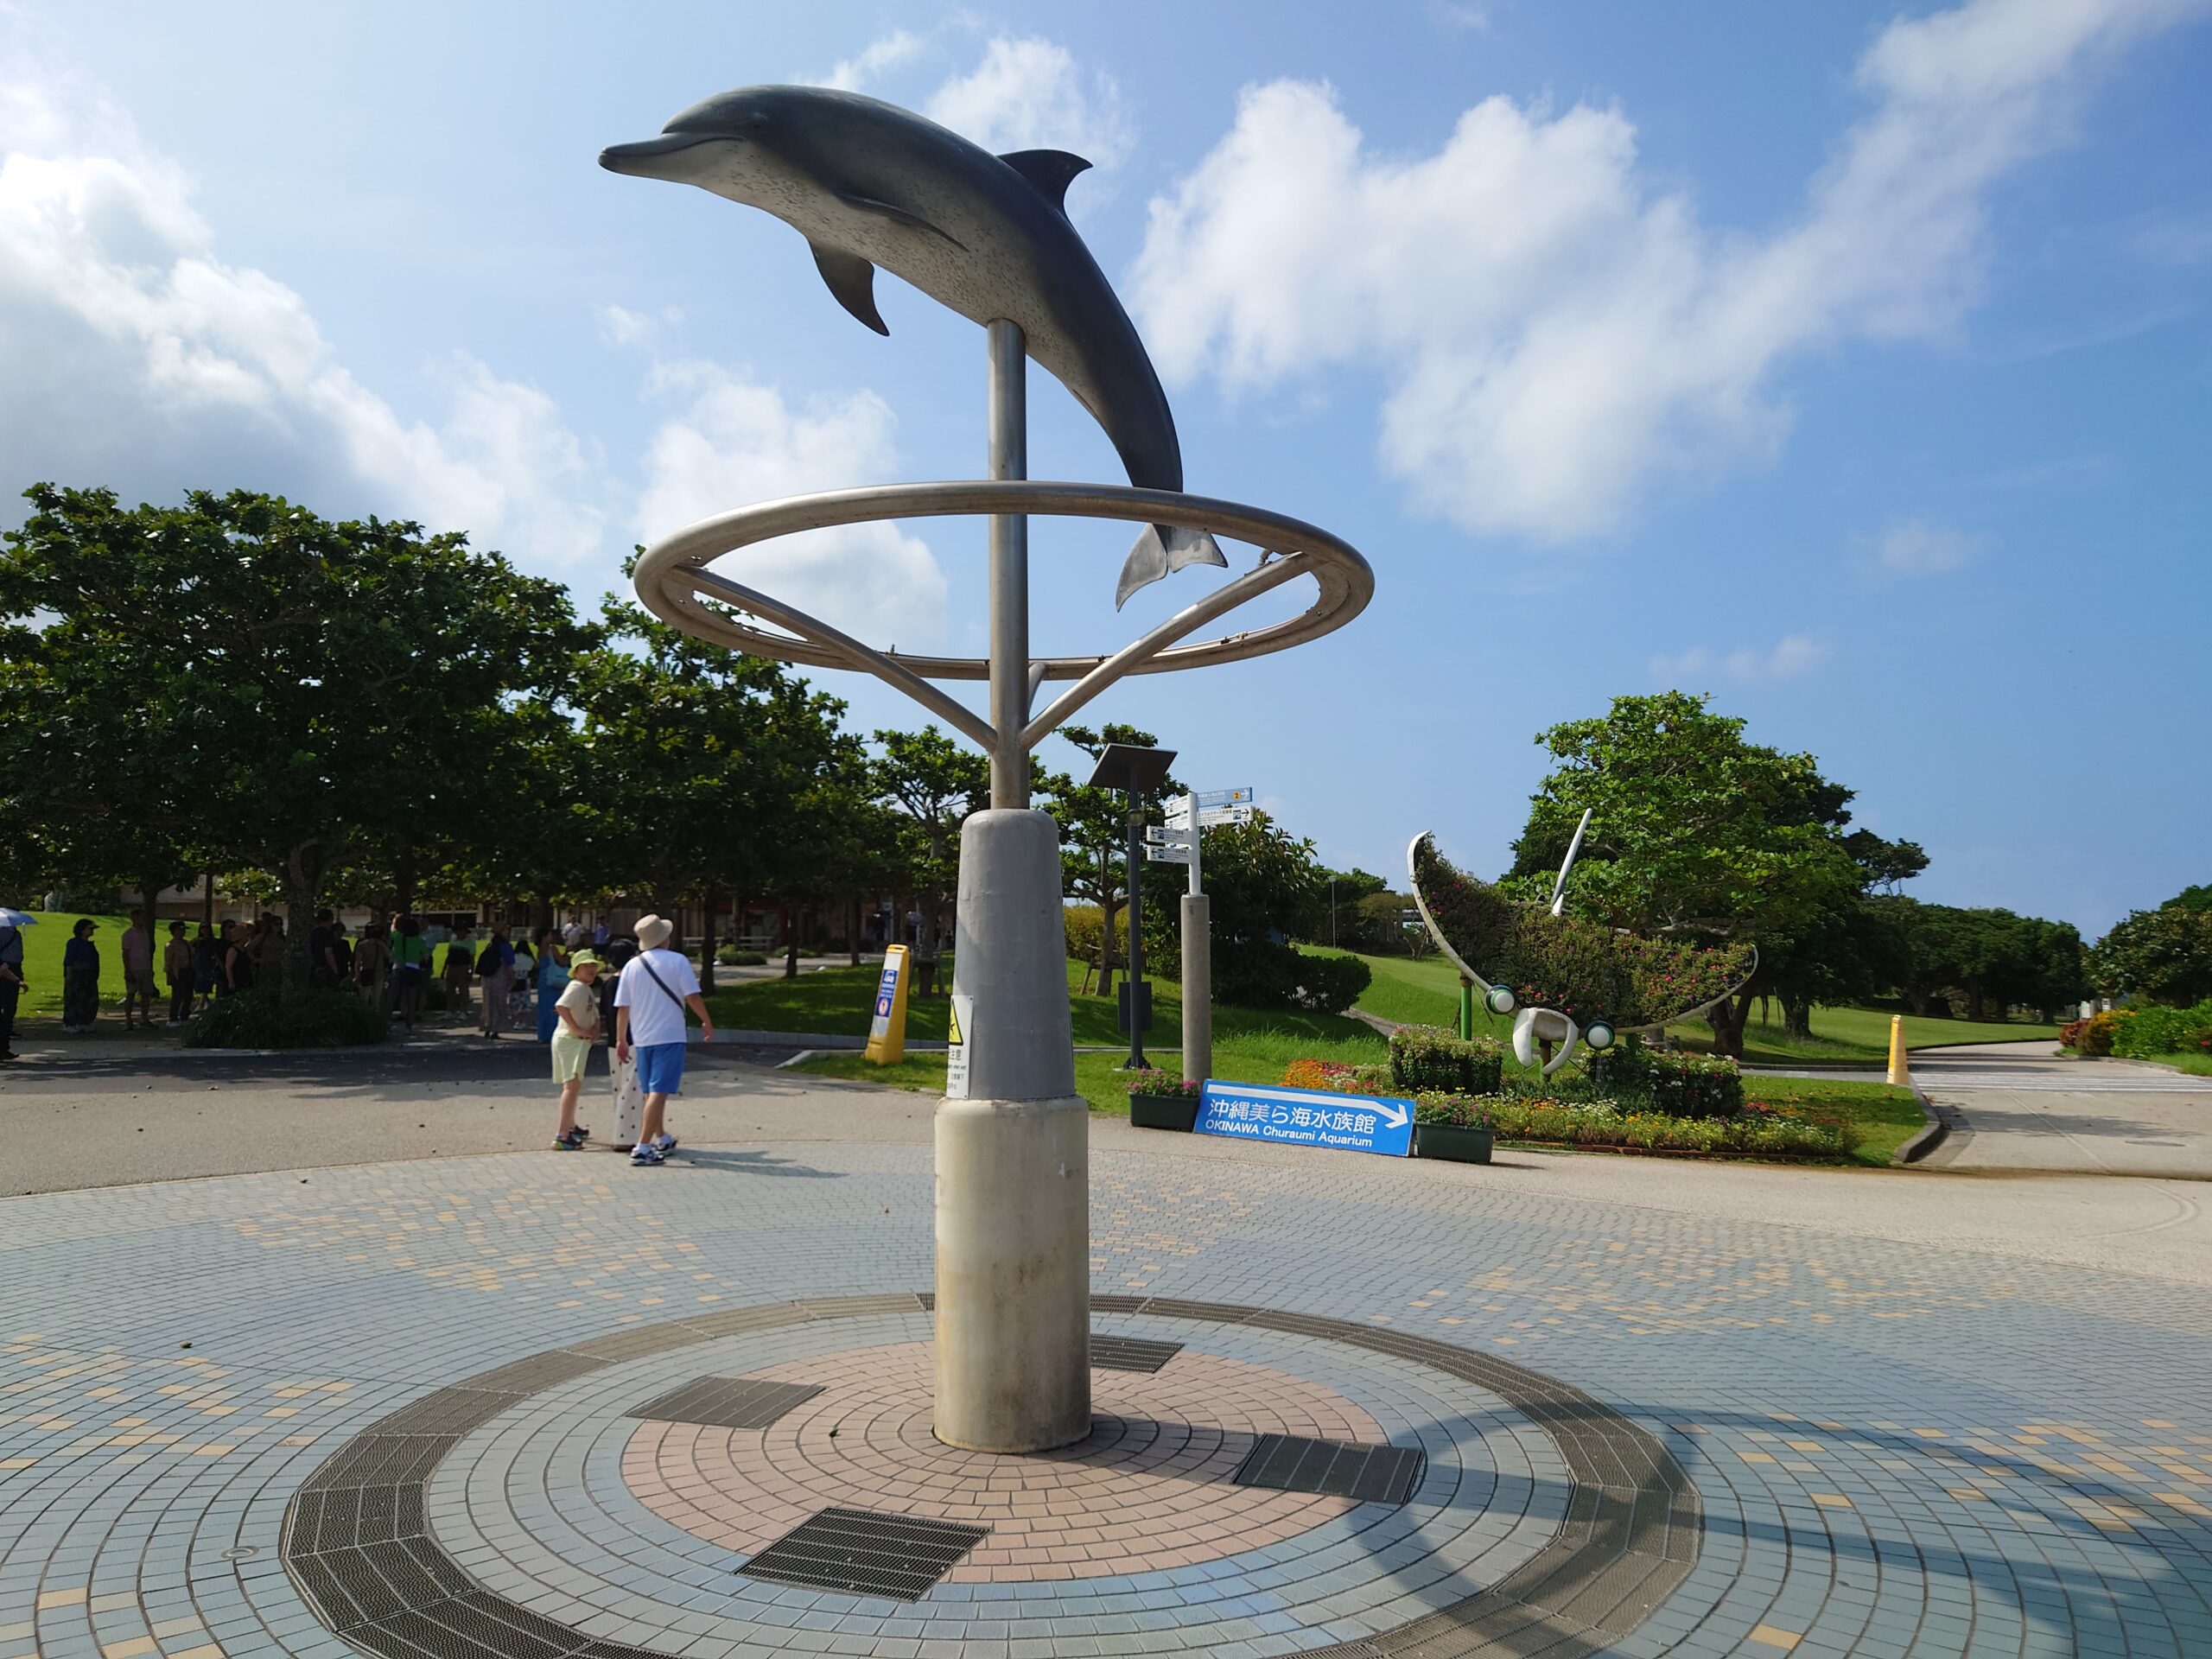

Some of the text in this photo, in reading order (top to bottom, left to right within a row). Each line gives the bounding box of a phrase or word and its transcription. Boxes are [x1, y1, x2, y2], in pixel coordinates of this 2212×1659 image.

[1208, 1098, 1376, 1135] 沖縄美ら海水族館
[1205, 1119, 1372, 1147] OKINAWA Churaumi Aquarium
